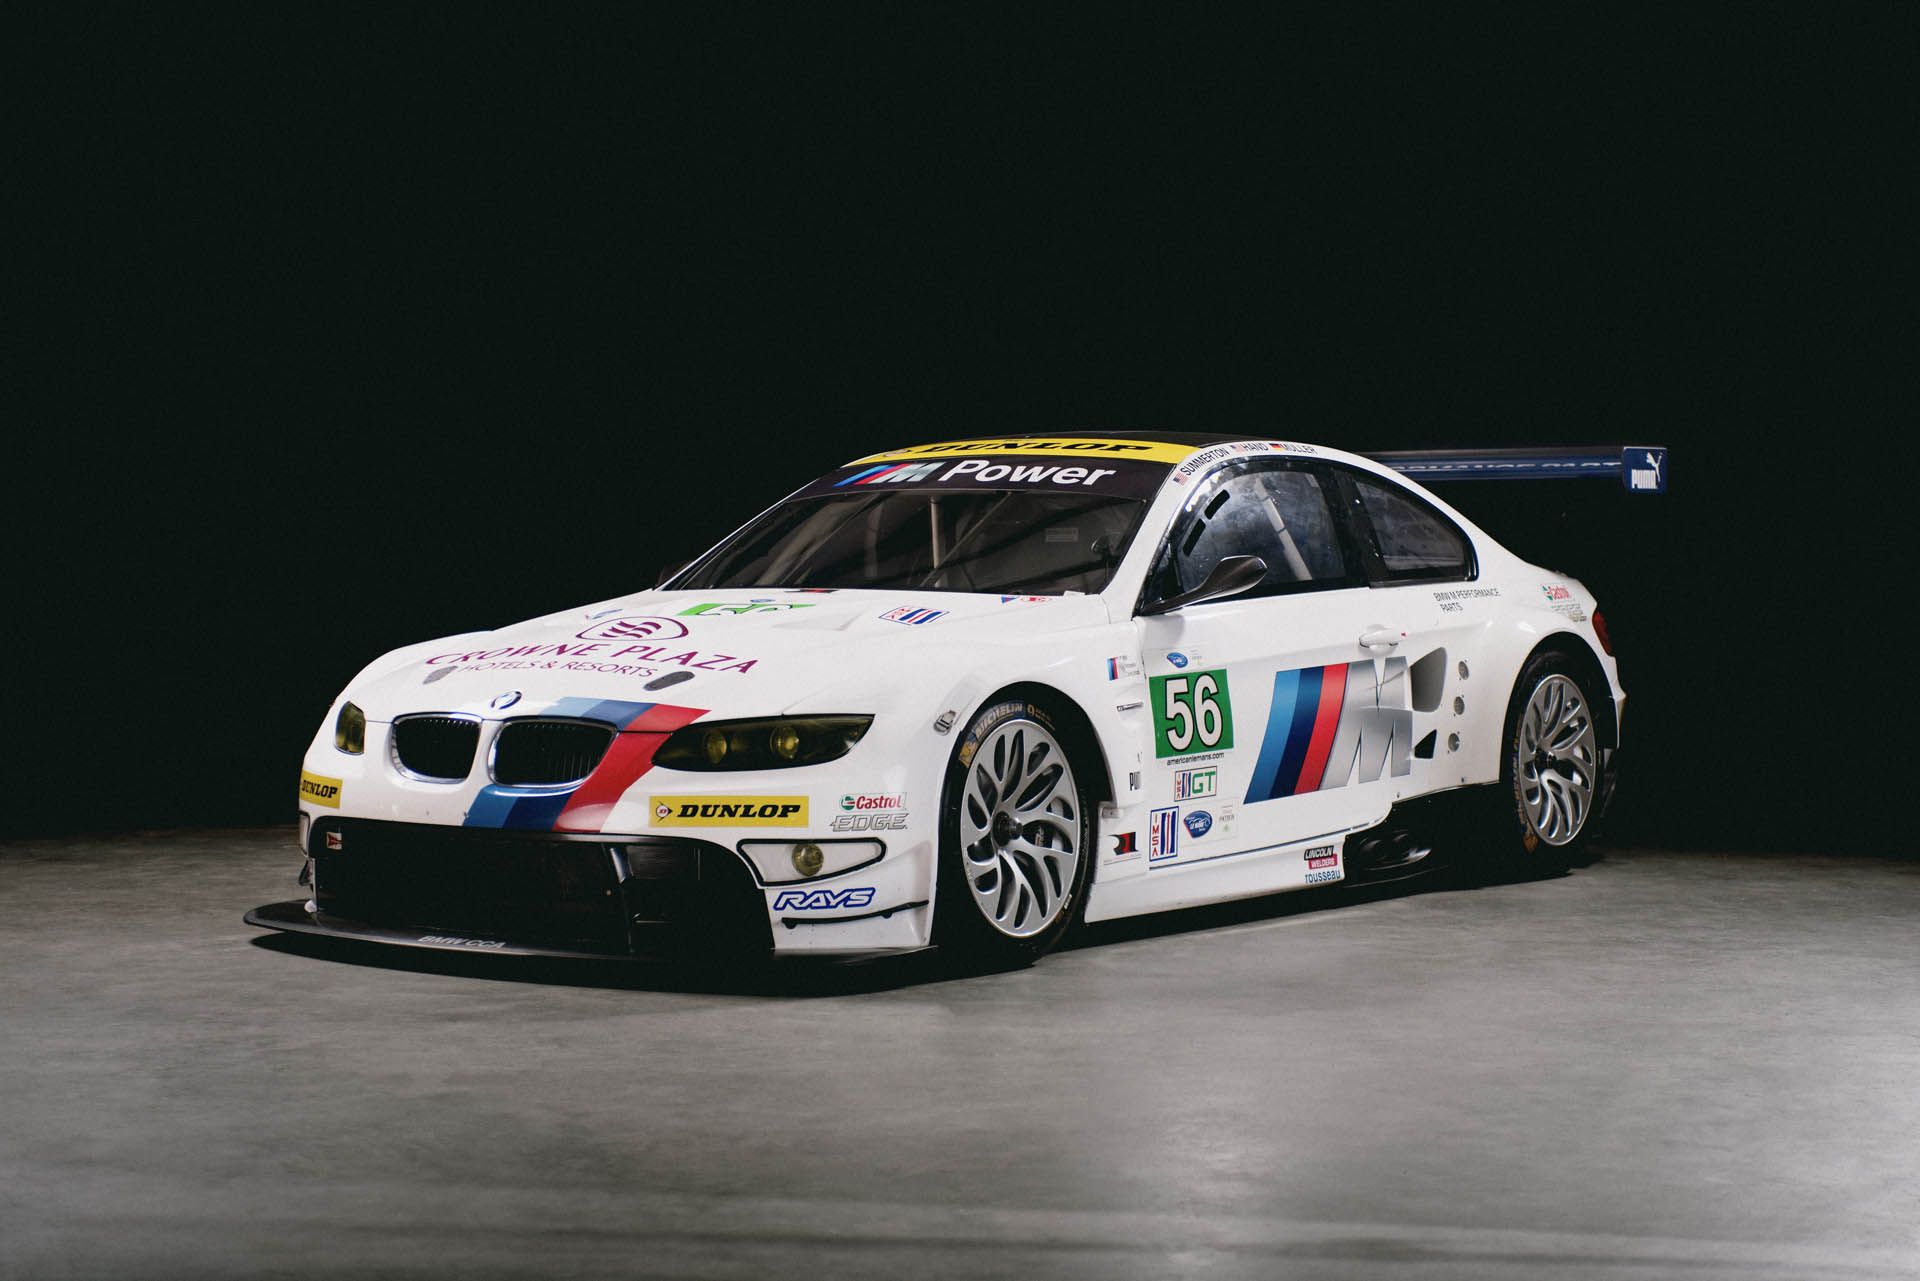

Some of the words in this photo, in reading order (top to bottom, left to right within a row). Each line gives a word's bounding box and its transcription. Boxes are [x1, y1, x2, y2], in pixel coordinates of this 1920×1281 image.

[914, 442, 1153, 453] DUNLOP
[1180, 448, 1231, 476] SUMMERTON
[937, 460, 1117, 486] Power
[1433, 592, 1451, 602] BMW
[1457, 588, 1501, 599] PERFORMANCE
[1440, 602, 1463, 613] PARTS
[425, 643, 612, 665] CROWNE
[610, 645, 759, 674] PLAZA
[458, 660, 541, 673] HOTELS
[541, 660, 558, 669] &
[560, 661, 659, 677] RESORTS
[1164, 672, 1223, 752] 56
[1166, 751, 1225, 766] americanlemans.com
[301, 779, 339, 798] DUNLOP
[1191, 770, 1217, 794] GT
[677, 804, 801, 818] DUNLOP
[855, 794, 903, 810] Castrol
[831, 812, 909, 833] EDGE
[1151, 813, 1160, 857] IMSA
[1305, 846, 1334, 859] LINCOLN
[1305, 869, 1341, 883] rousseau
[773, 886, 876, 911] RAYS
